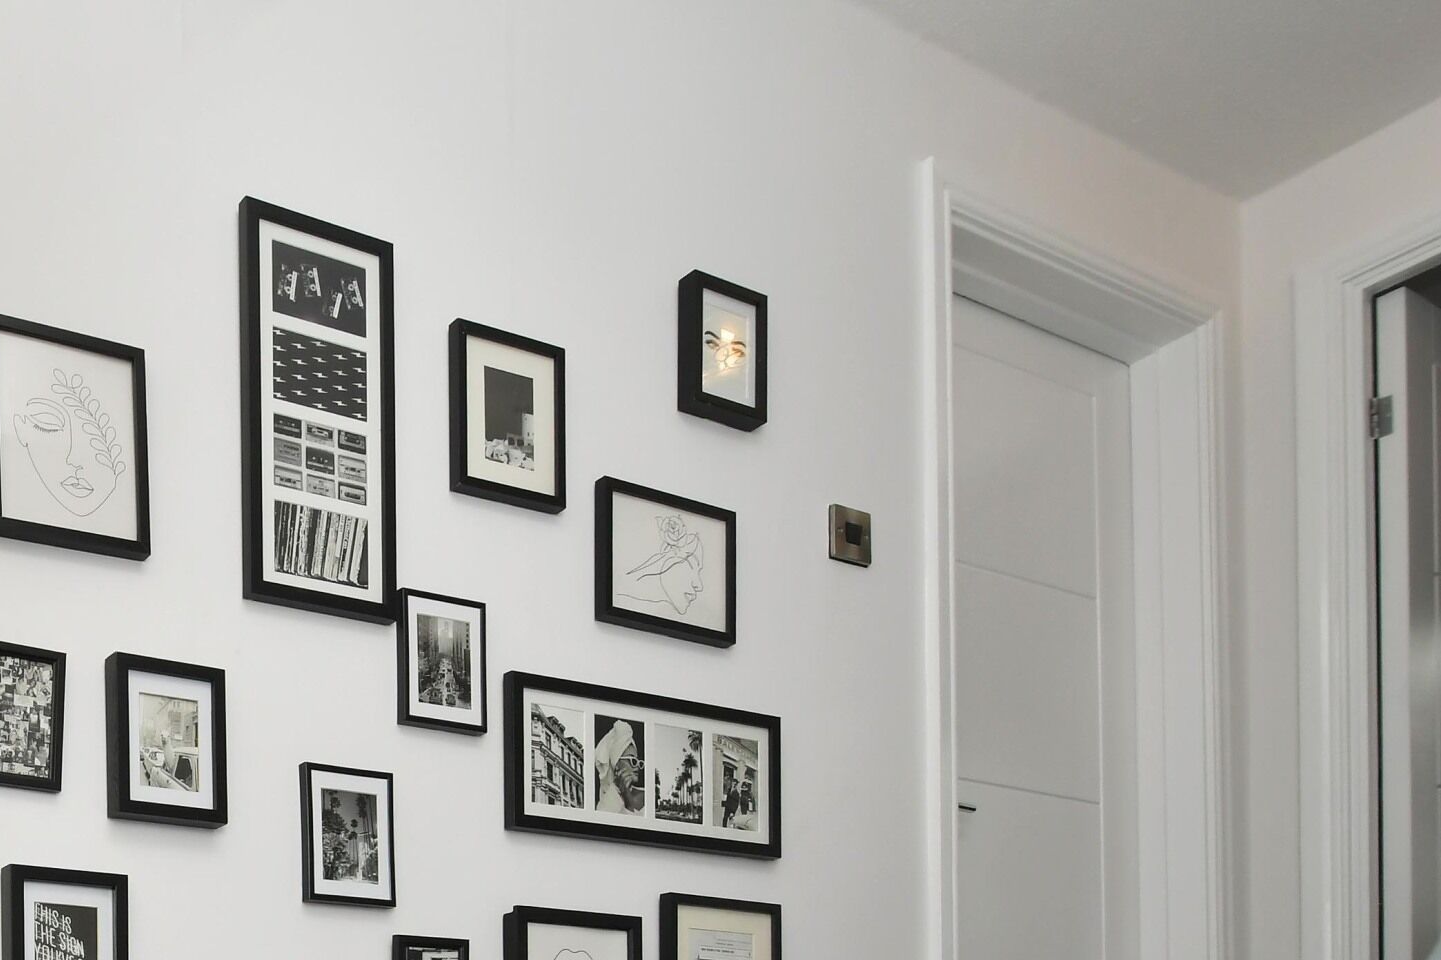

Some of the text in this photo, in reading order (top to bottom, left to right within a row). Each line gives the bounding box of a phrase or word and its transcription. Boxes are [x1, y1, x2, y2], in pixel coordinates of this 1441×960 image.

[34, 902, 72, 935] THIS IS
[34, 920, 85, 959] THE SIGN
